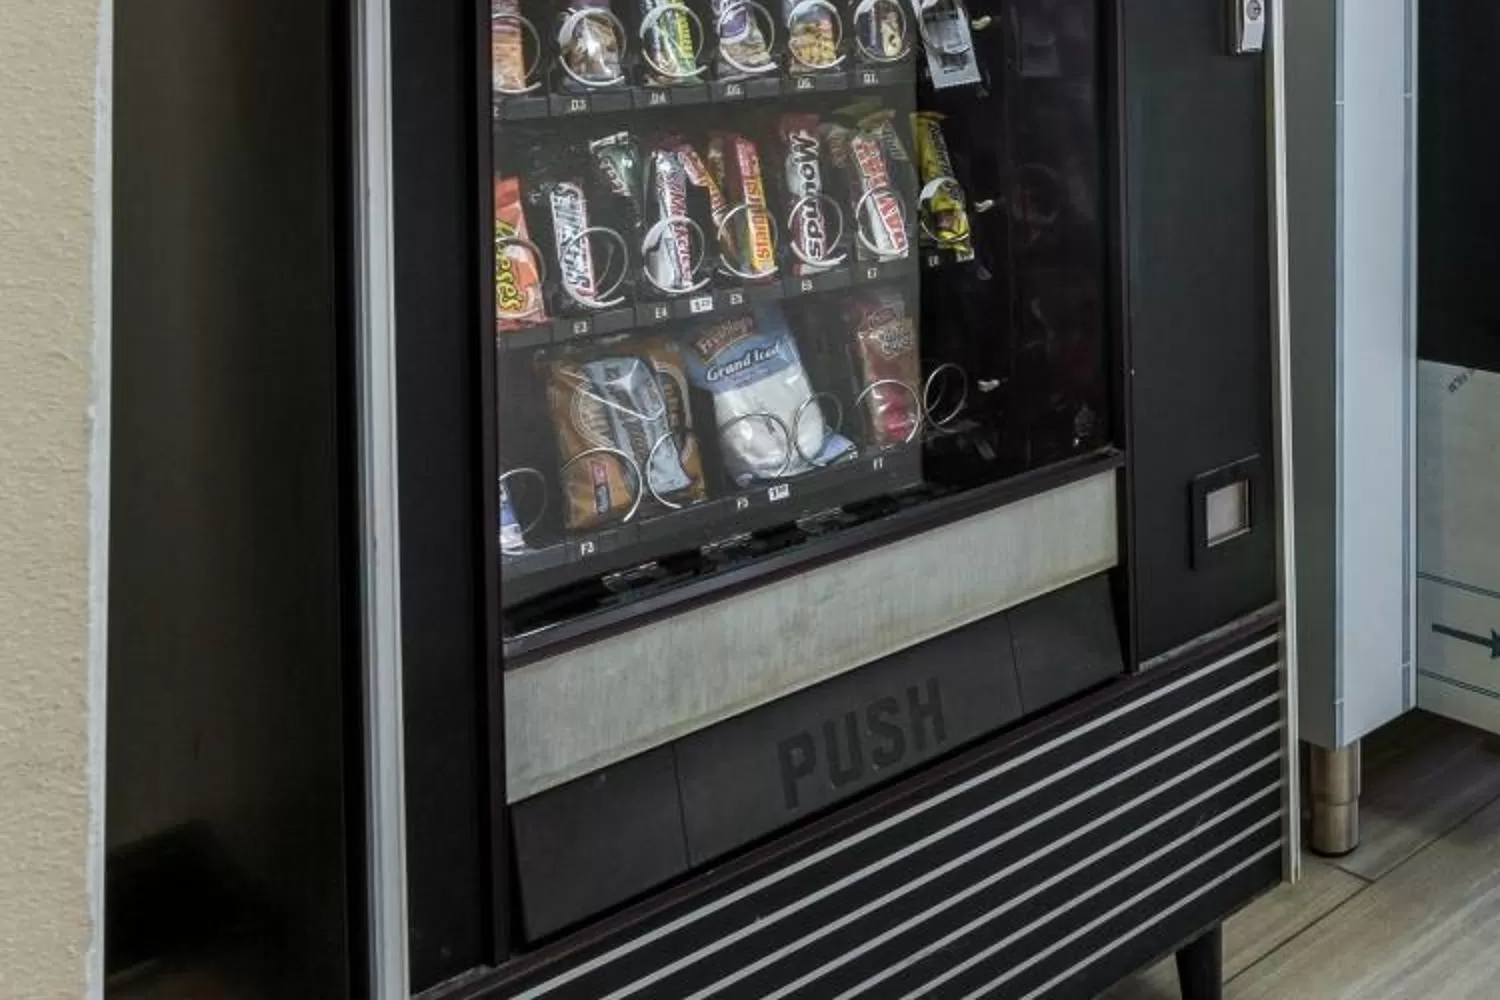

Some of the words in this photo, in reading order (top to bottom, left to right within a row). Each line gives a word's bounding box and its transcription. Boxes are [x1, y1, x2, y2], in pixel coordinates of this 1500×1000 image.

[790, 134, 824, 261] Mounds
[706, 350, 751, 382] Grand
[754, 339, 782, 363] Iced
[580, 541, 595, 556] F3
[776, 675, 947, 811] PUSH
